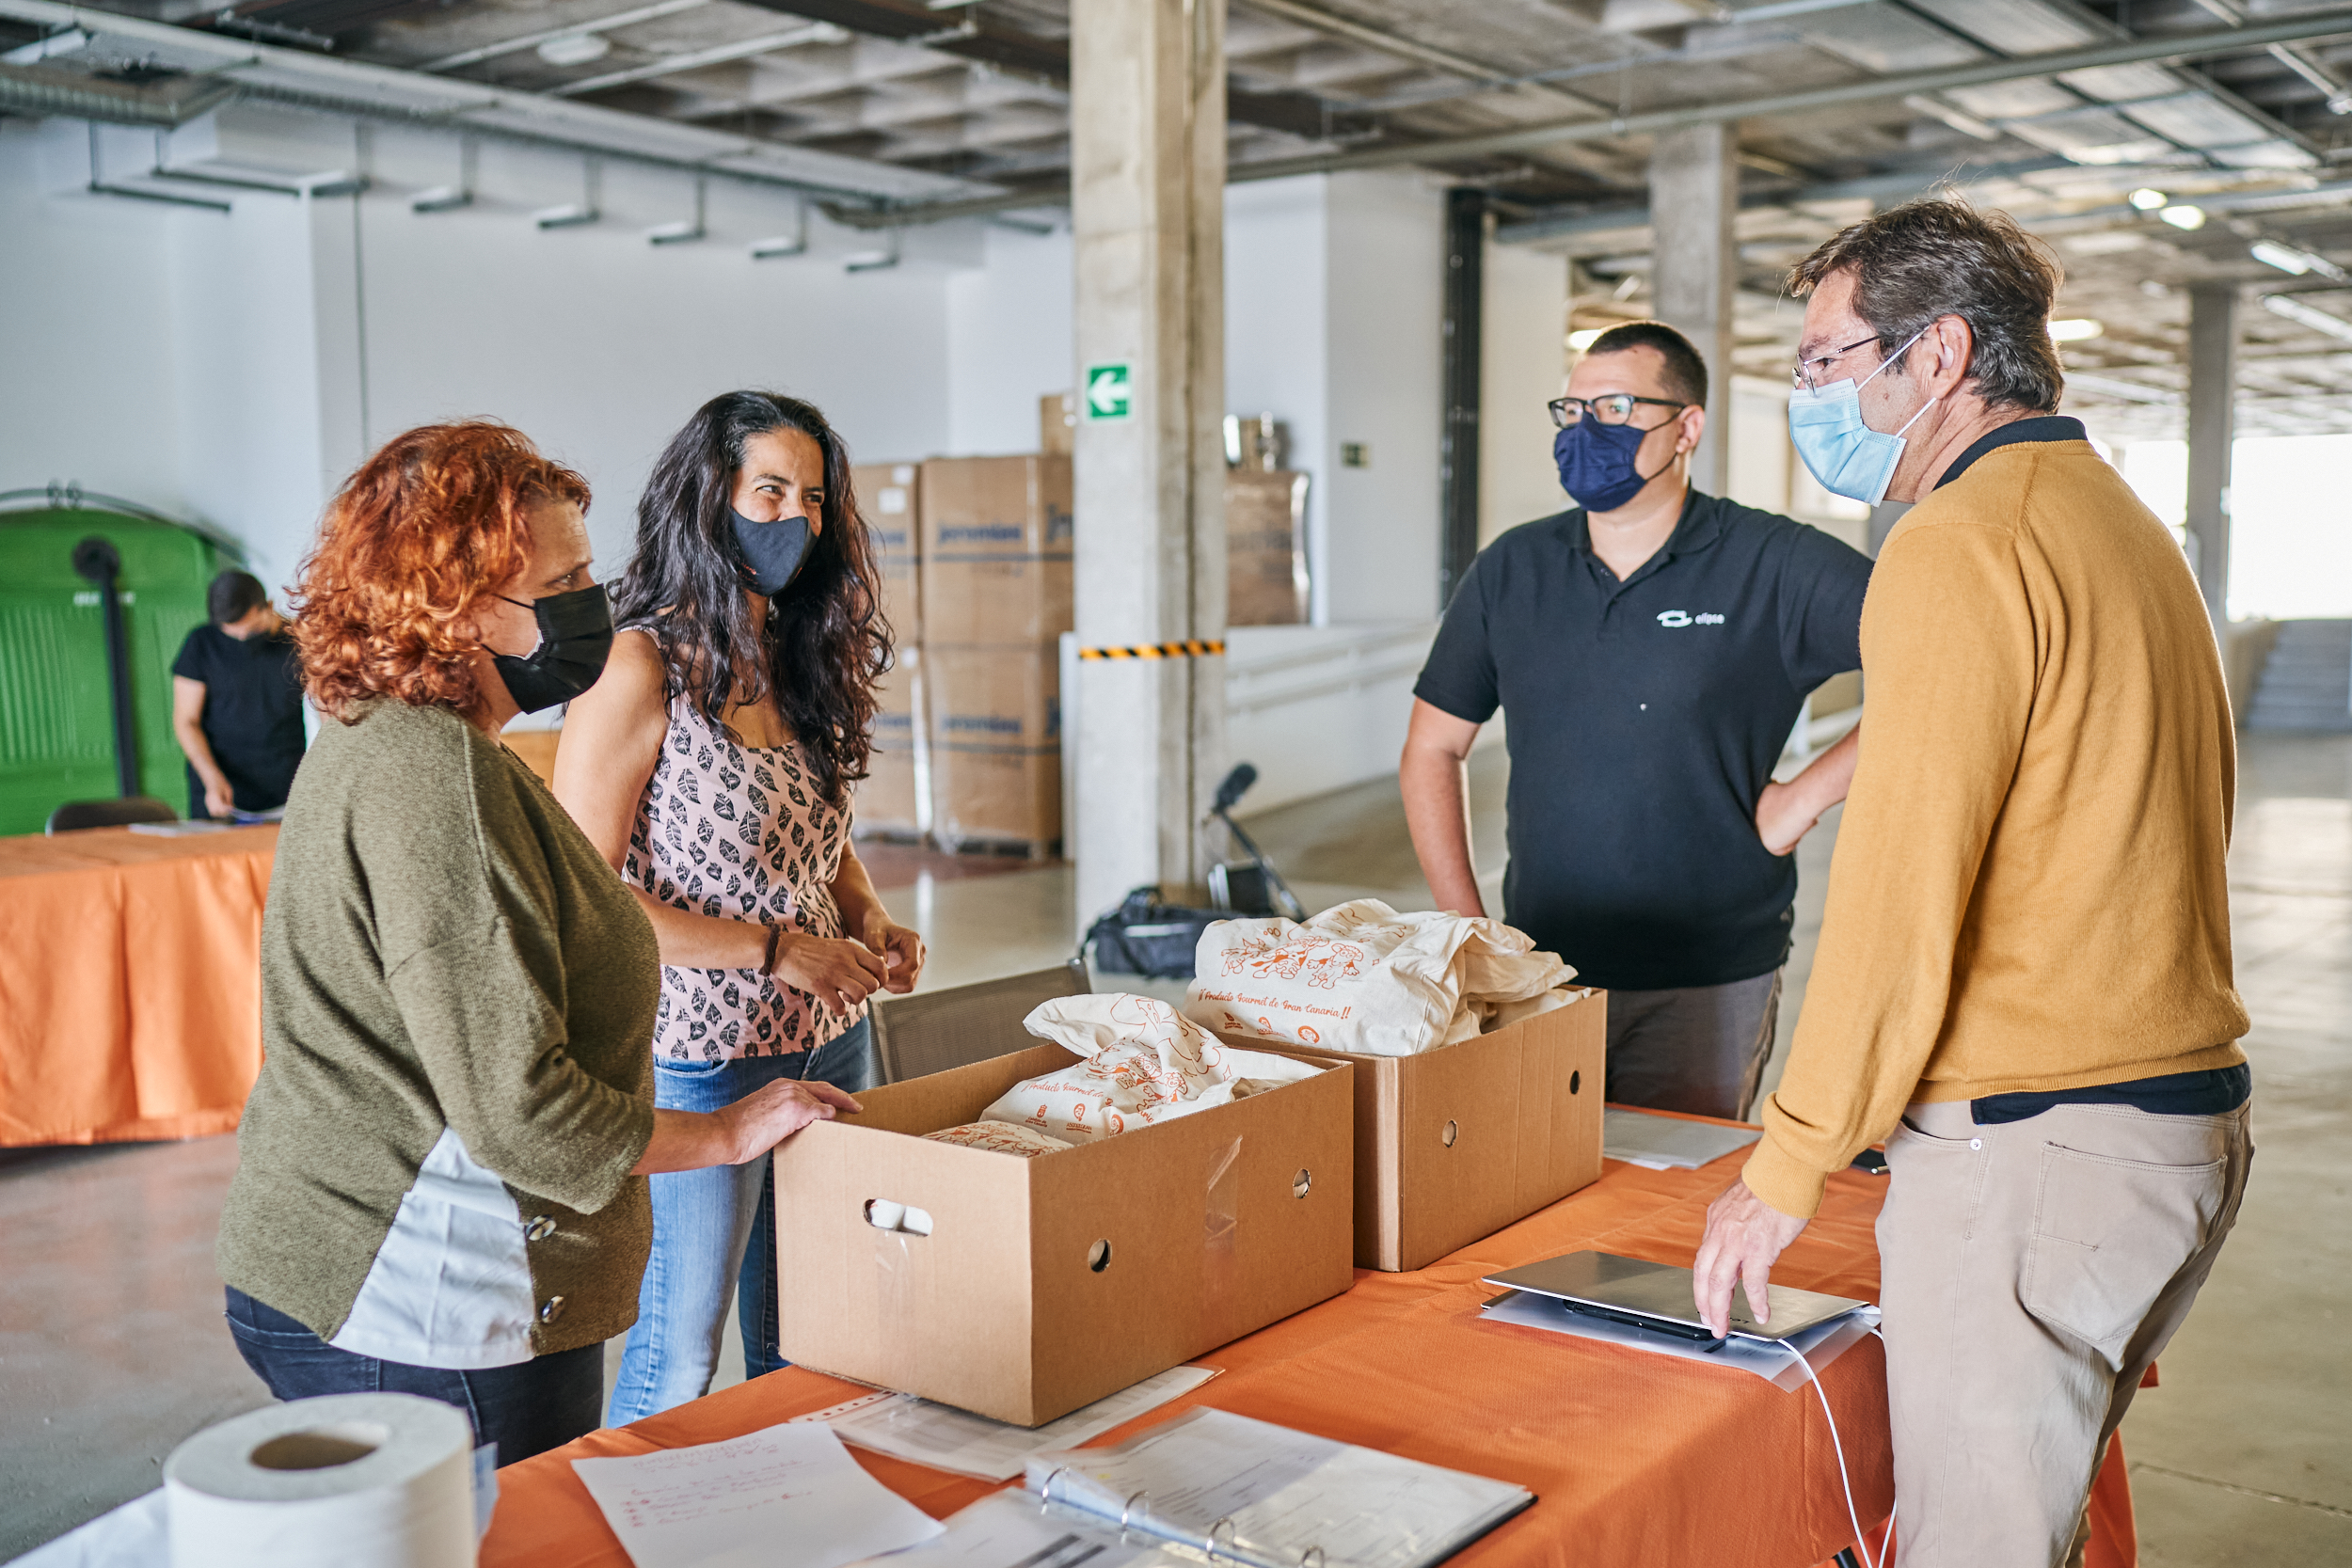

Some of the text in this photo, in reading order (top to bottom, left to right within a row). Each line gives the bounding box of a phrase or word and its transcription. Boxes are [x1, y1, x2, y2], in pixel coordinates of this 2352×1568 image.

[1237, 992, 1268, 1006] Gourmet
[1269, 997, 1279, 1007] de
[1282, 1000, 1302, 1012] Gran
[1062, 1082, 1094, 1096] Gourmet
